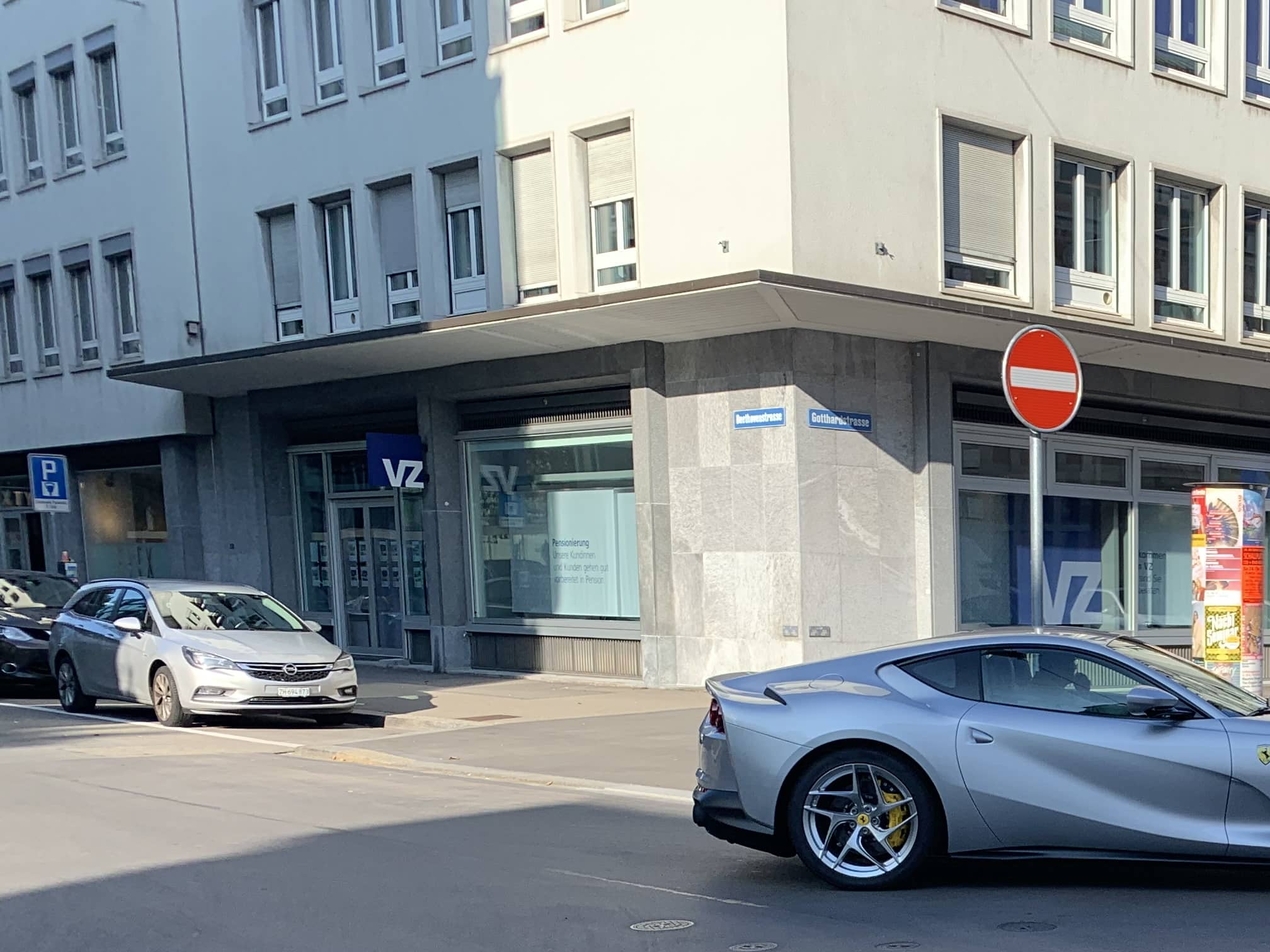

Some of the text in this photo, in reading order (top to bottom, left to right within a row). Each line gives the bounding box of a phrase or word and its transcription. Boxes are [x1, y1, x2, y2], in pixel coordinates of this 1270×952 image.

[811, 412, 870, 428] Gotthardstrasse
[41, 459, 57, 480] P
[381, 458, 424, 489] VZ
[551, 538, 590, 549] Pensionierung
[1043, 561, 1102, 625] VZ
